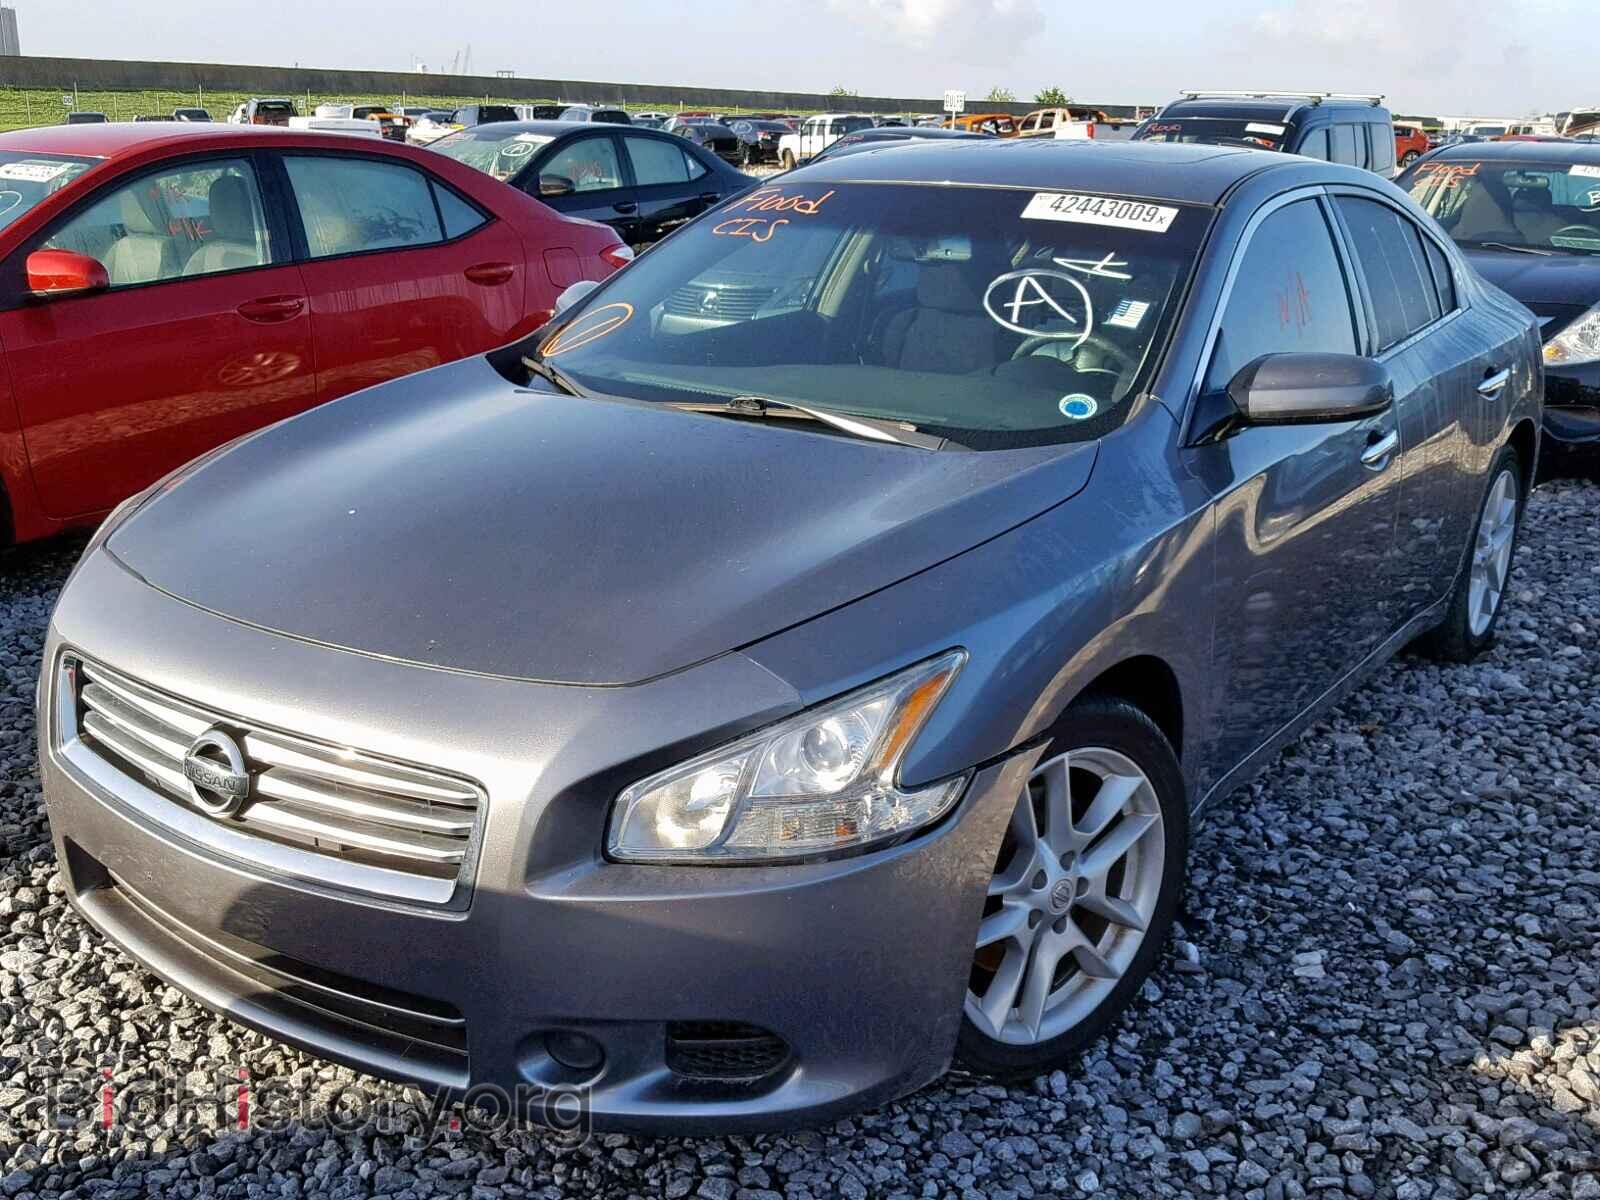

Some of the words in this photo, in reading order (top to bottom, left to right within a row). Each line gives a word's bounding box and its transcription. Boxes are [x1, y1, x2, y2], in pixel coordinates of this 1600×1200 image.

[1412, 162, 1481, 176] Flood
[721, 186, 836, 214] Flood
[1049, 195, 1160, 223] 42443009
[712, 217, 790, 242] CIS
[1003, 276, 1077, 324] A
[184, 758, 237, 792] NISSAN
